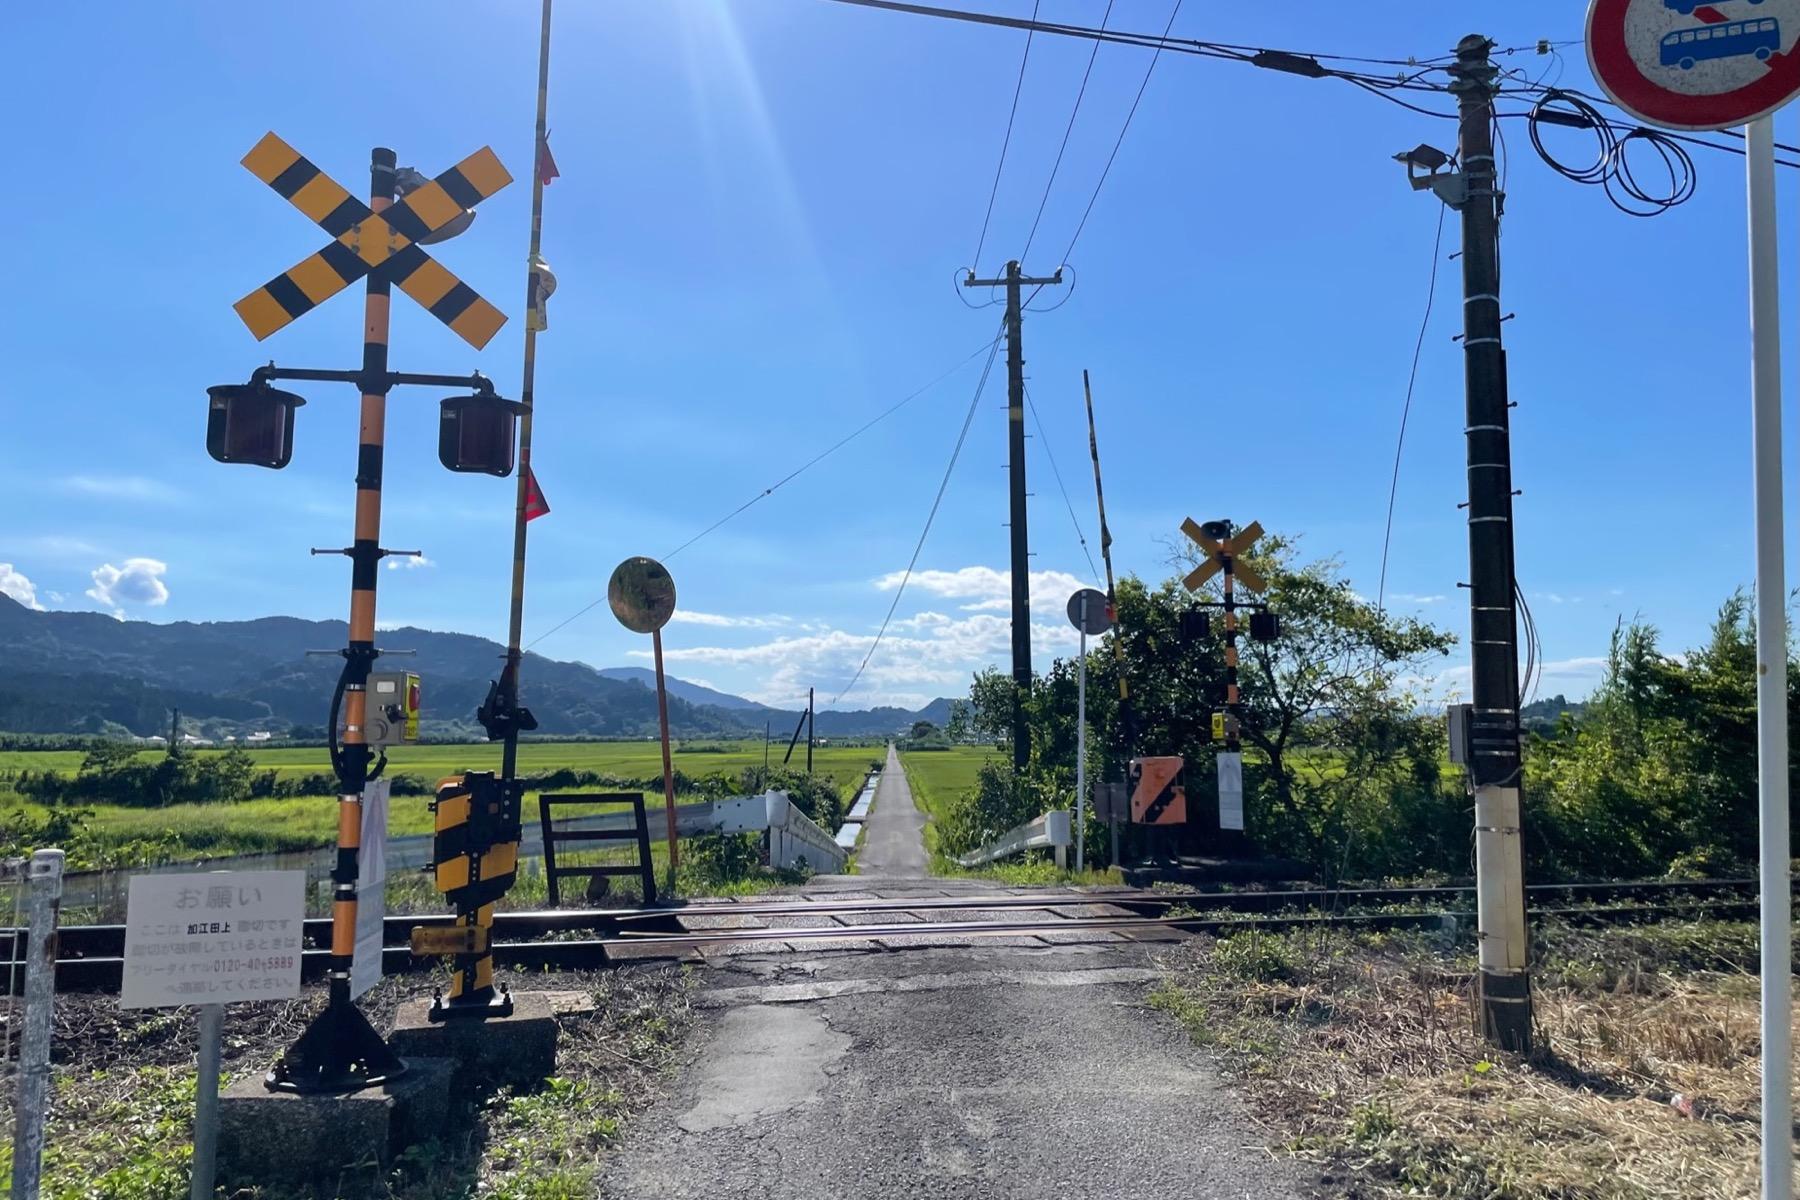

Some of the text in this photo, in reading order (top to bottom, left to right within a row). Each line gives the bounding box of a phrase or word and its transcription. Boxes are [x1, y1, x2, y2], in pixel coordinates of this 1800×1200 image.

[175, 886, 263, 909] お願い
[141, 924, 181, 937] ここは
[187, 921, 231, 935] 加江田上
